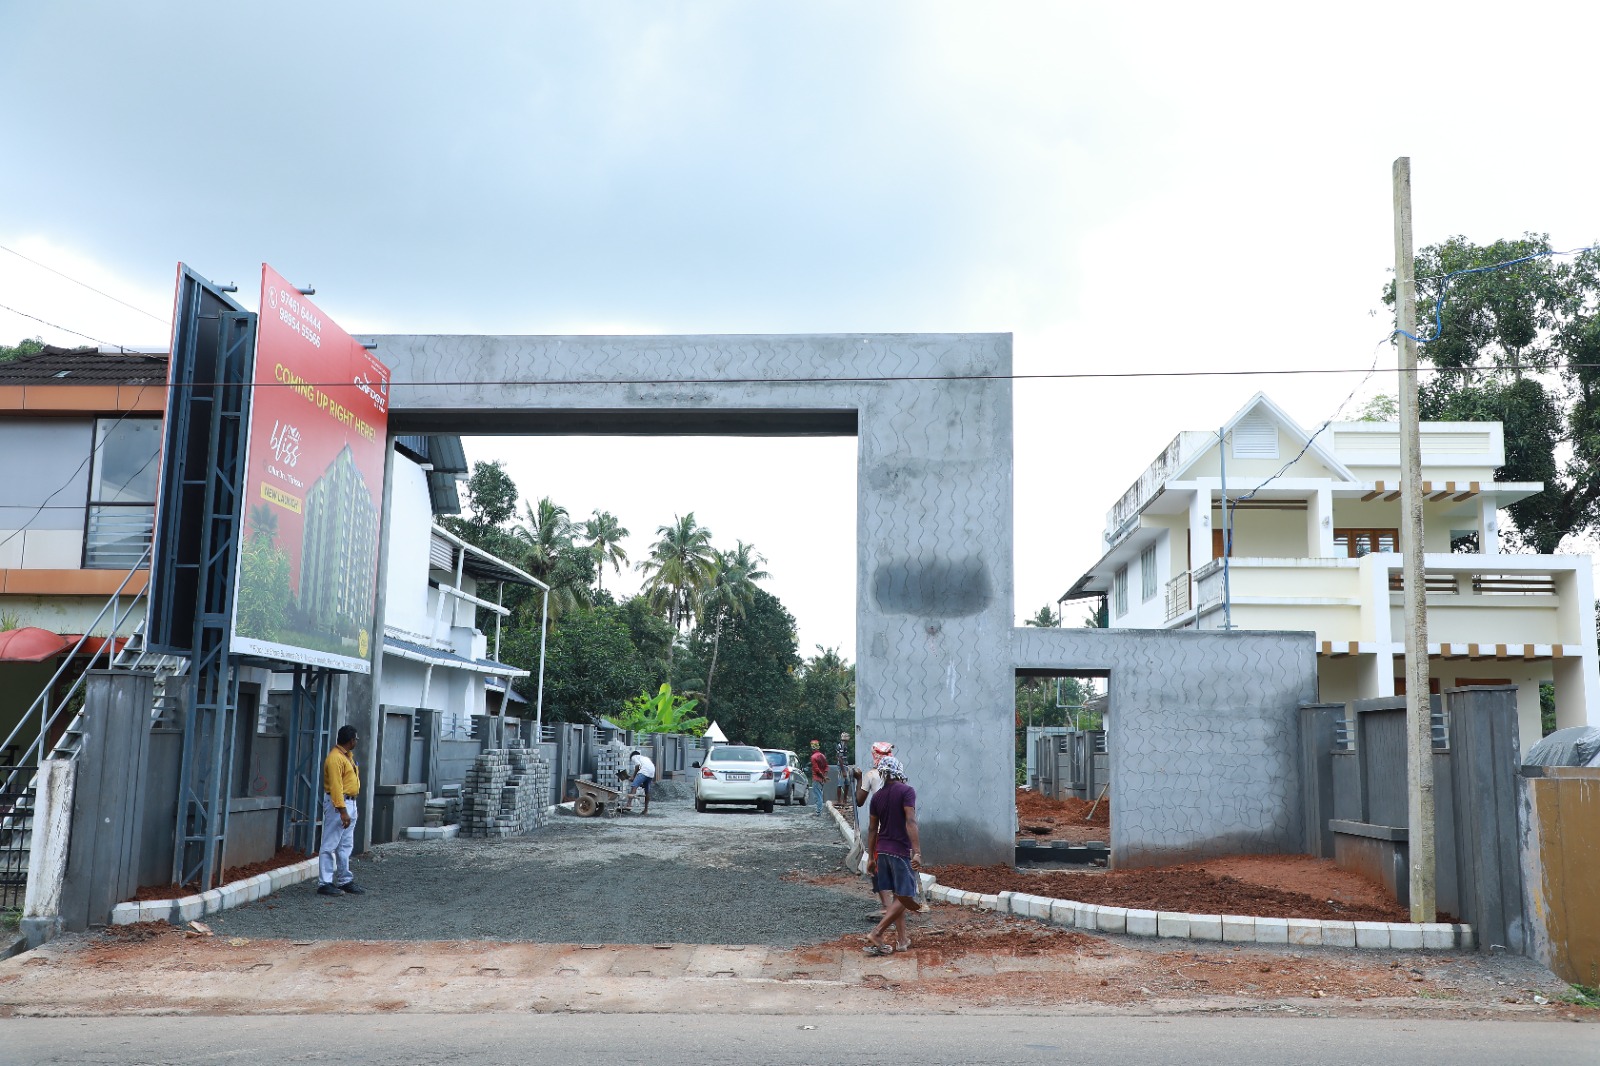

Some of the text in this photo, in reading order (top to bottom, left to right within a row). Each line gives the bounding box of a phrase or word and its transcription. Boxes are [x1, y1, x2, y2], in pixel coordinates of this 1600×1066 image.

[275, 362, 314, 402] COMING
[316, 390, 328, 411] UP
[329, 400, 354, 428] RIGHT
[355, 417, 376, 443] HERE!
[269, 419, 302, 467] bliss
[264, 486, 277, 500] NEW
